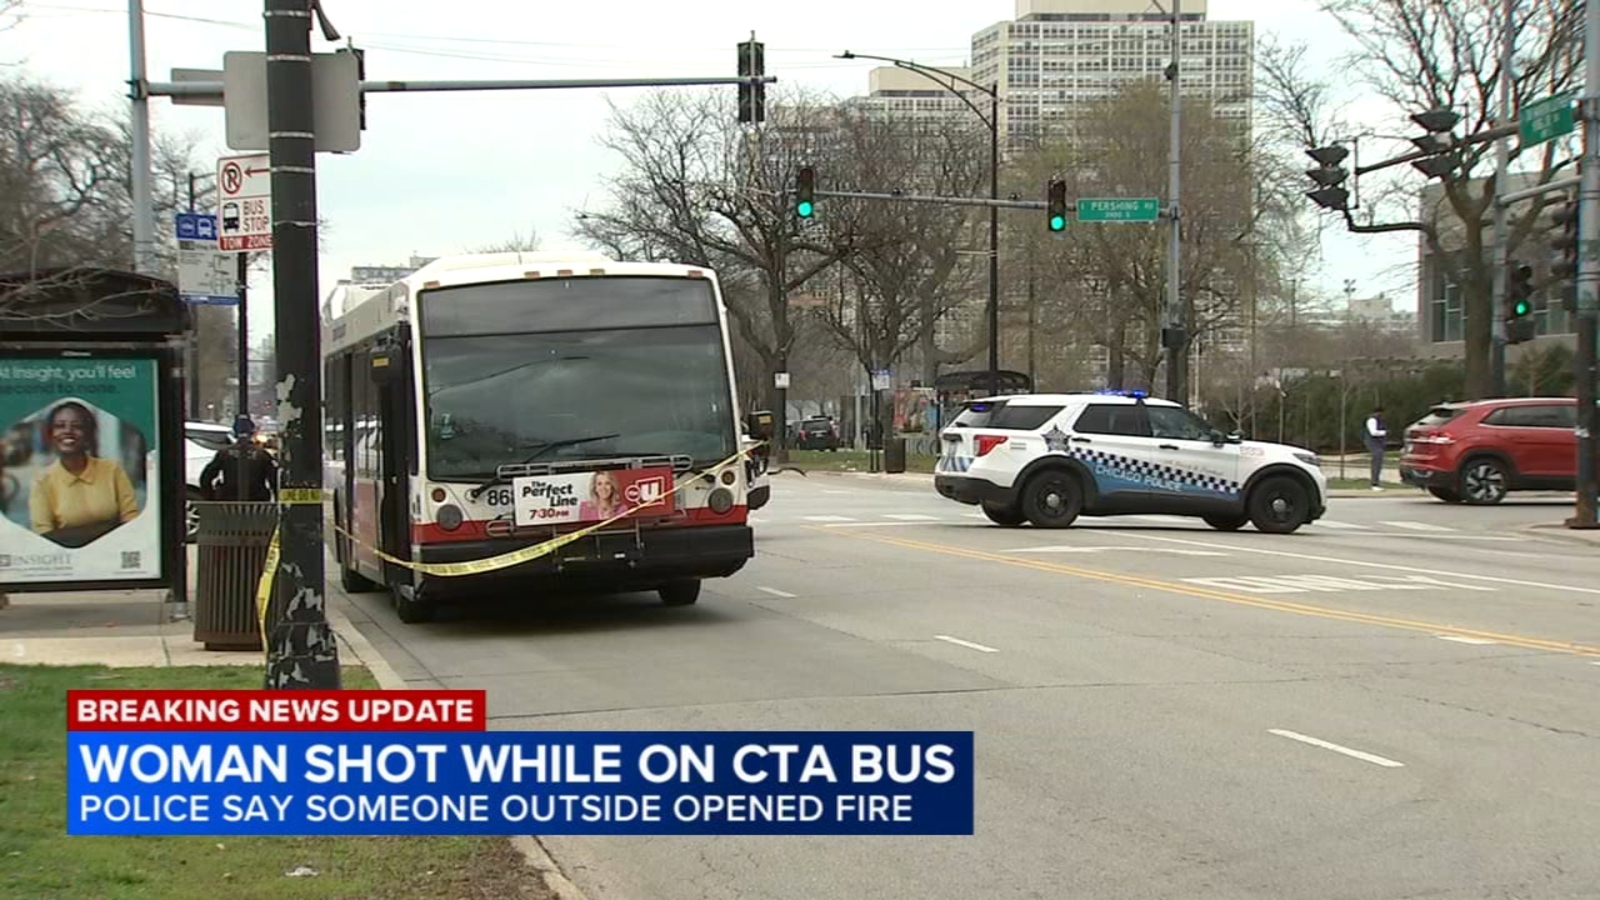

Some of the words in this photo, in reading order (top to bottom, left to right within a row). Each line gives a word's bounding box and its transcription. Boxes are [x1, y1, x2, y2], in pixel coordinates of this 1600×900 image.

[242, 200, 263, 216] BUS
[1091, 201, 1139, 211] PERSHING
[242, 216, 269, 232] STOP
[223, 237, 243, 250] TOW
[248, 234, 272, 249] ZONE
[13, 365, 65, 381] Insight,
[68, 365, 105, 381] you'll
[107, 365, 136, 378] feel
[57, 382, 73, 394] to
[1095, 464, 1141, 482] CHICAGO
[1145, 475, 1183, 491] POLICE
[522, 484, 573, 498] Perfect
[550, 496, 578, 507] Line
[11, 553, 72, 566] INSIGHT
